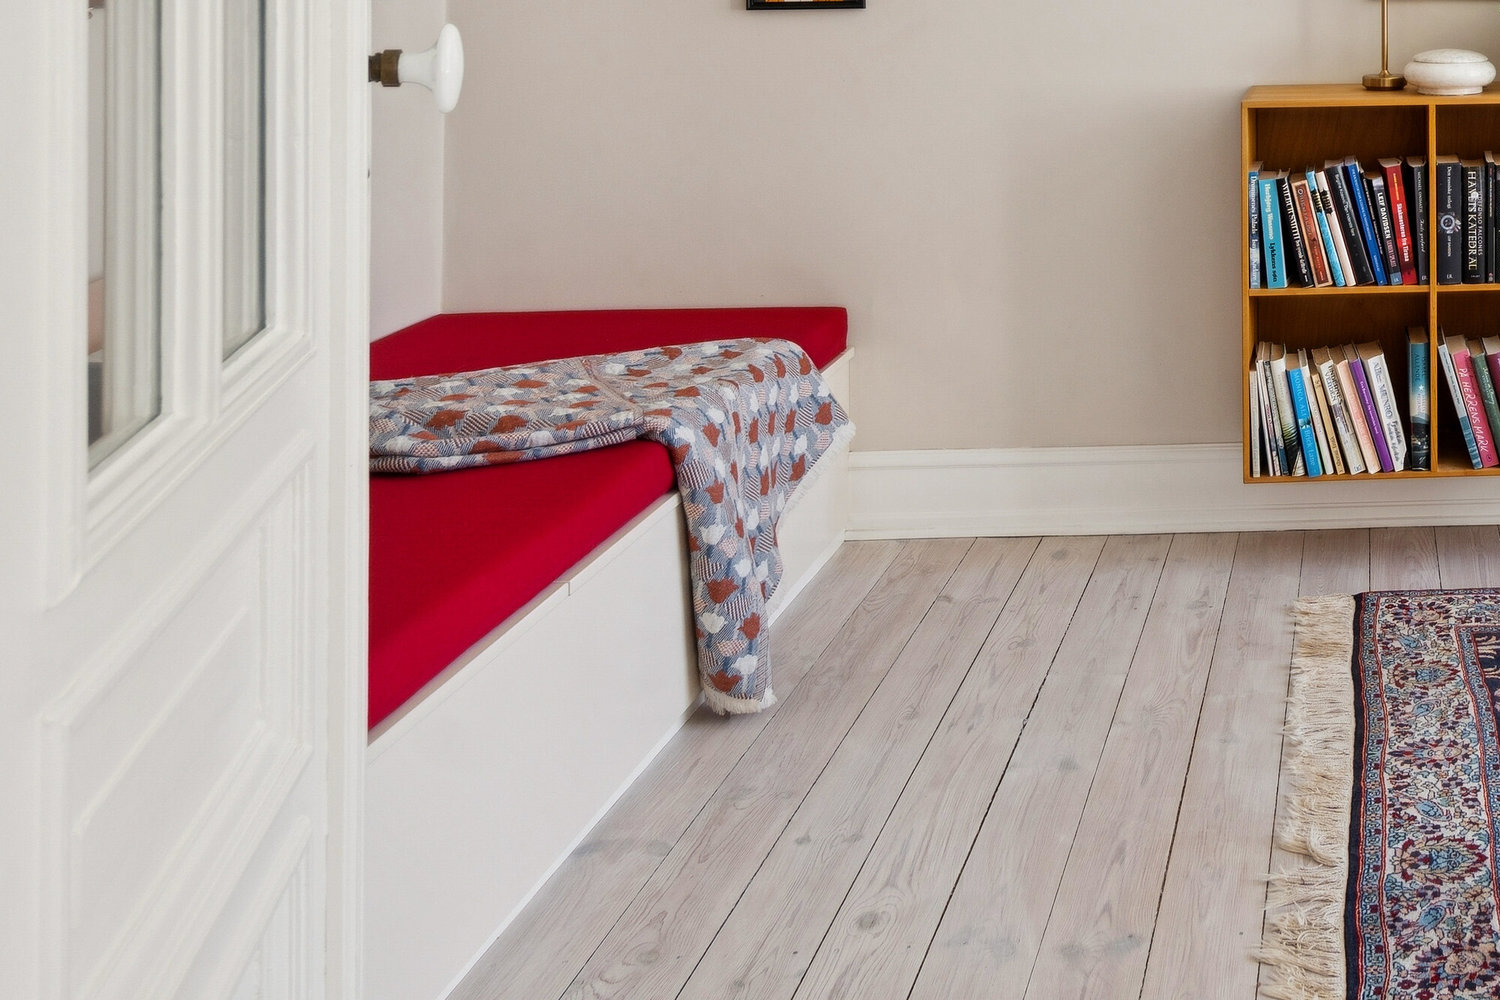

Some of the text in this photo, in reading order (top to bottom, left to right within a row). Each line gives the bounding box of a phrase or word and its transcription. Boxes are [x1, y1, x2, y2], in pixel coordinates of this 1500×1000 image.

[1377, 192, 1385, 207] LEIF
[1289, 214, 1300, 241] SMITH
[1380, 207, 1392, 240] DAVIDSEN
[1468, 214, 1477, 270] KATEDRAL
[1293, 371, 1304, 401] MONICA
[1462, 381, 1480, 424] HERRENS
[1474, 426, 1489, 453] MARK
